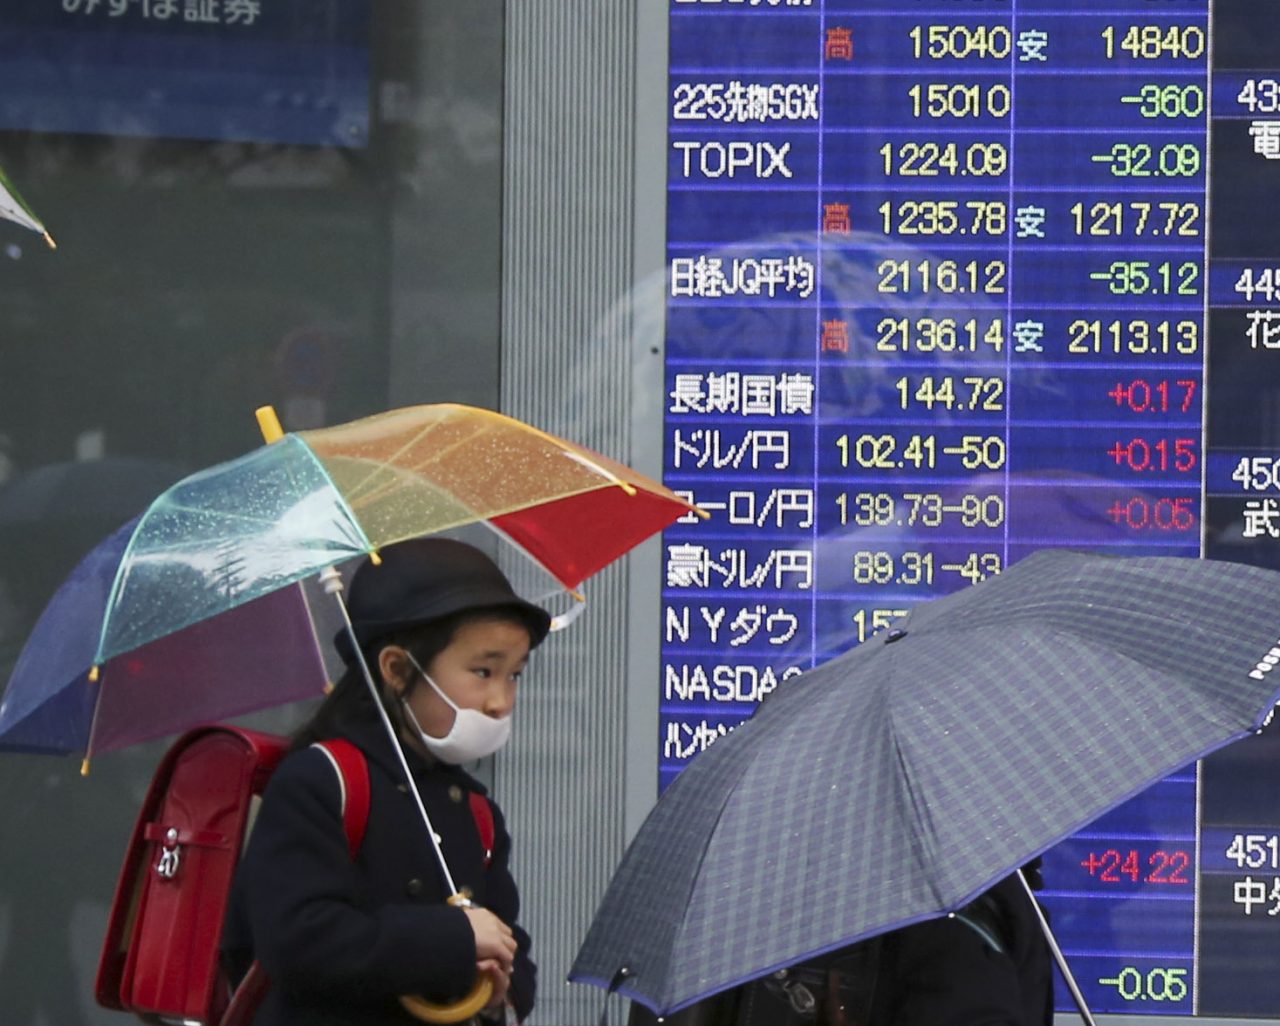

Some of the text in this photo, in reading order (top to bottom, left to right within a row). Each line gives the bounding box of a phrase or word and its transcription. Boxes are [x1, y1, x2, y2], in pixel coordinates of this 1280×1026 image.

[825, 25, 1204, 61] 高 15040 安 14840
[673, 81, 1204, 122] 225先物SGX 15010 -360
[673, 141, 1200, 178] TOPIX 1224.09 -32.09
[822, 201, 1199, 238] 高 1235.78 安 1217.72
[671, 255, 1198, 298] 日経JQ平均 2116.12 -35.12
[821, 318, 1198, 354] 高 2136.14 安 2113.13
[669, 371, 1197, 417] 長期国債 144.72 +0.17
[674, 429, 1197, 472] ドル/円 102.41-50 +0.15
[835, 492, 1006, 527] 139.73-90
[1106, 497, 1194, 531] +0.05
[1080, 849, 1190, 884] +24.22
[1098, 967, 1188, 1001] -0.05
